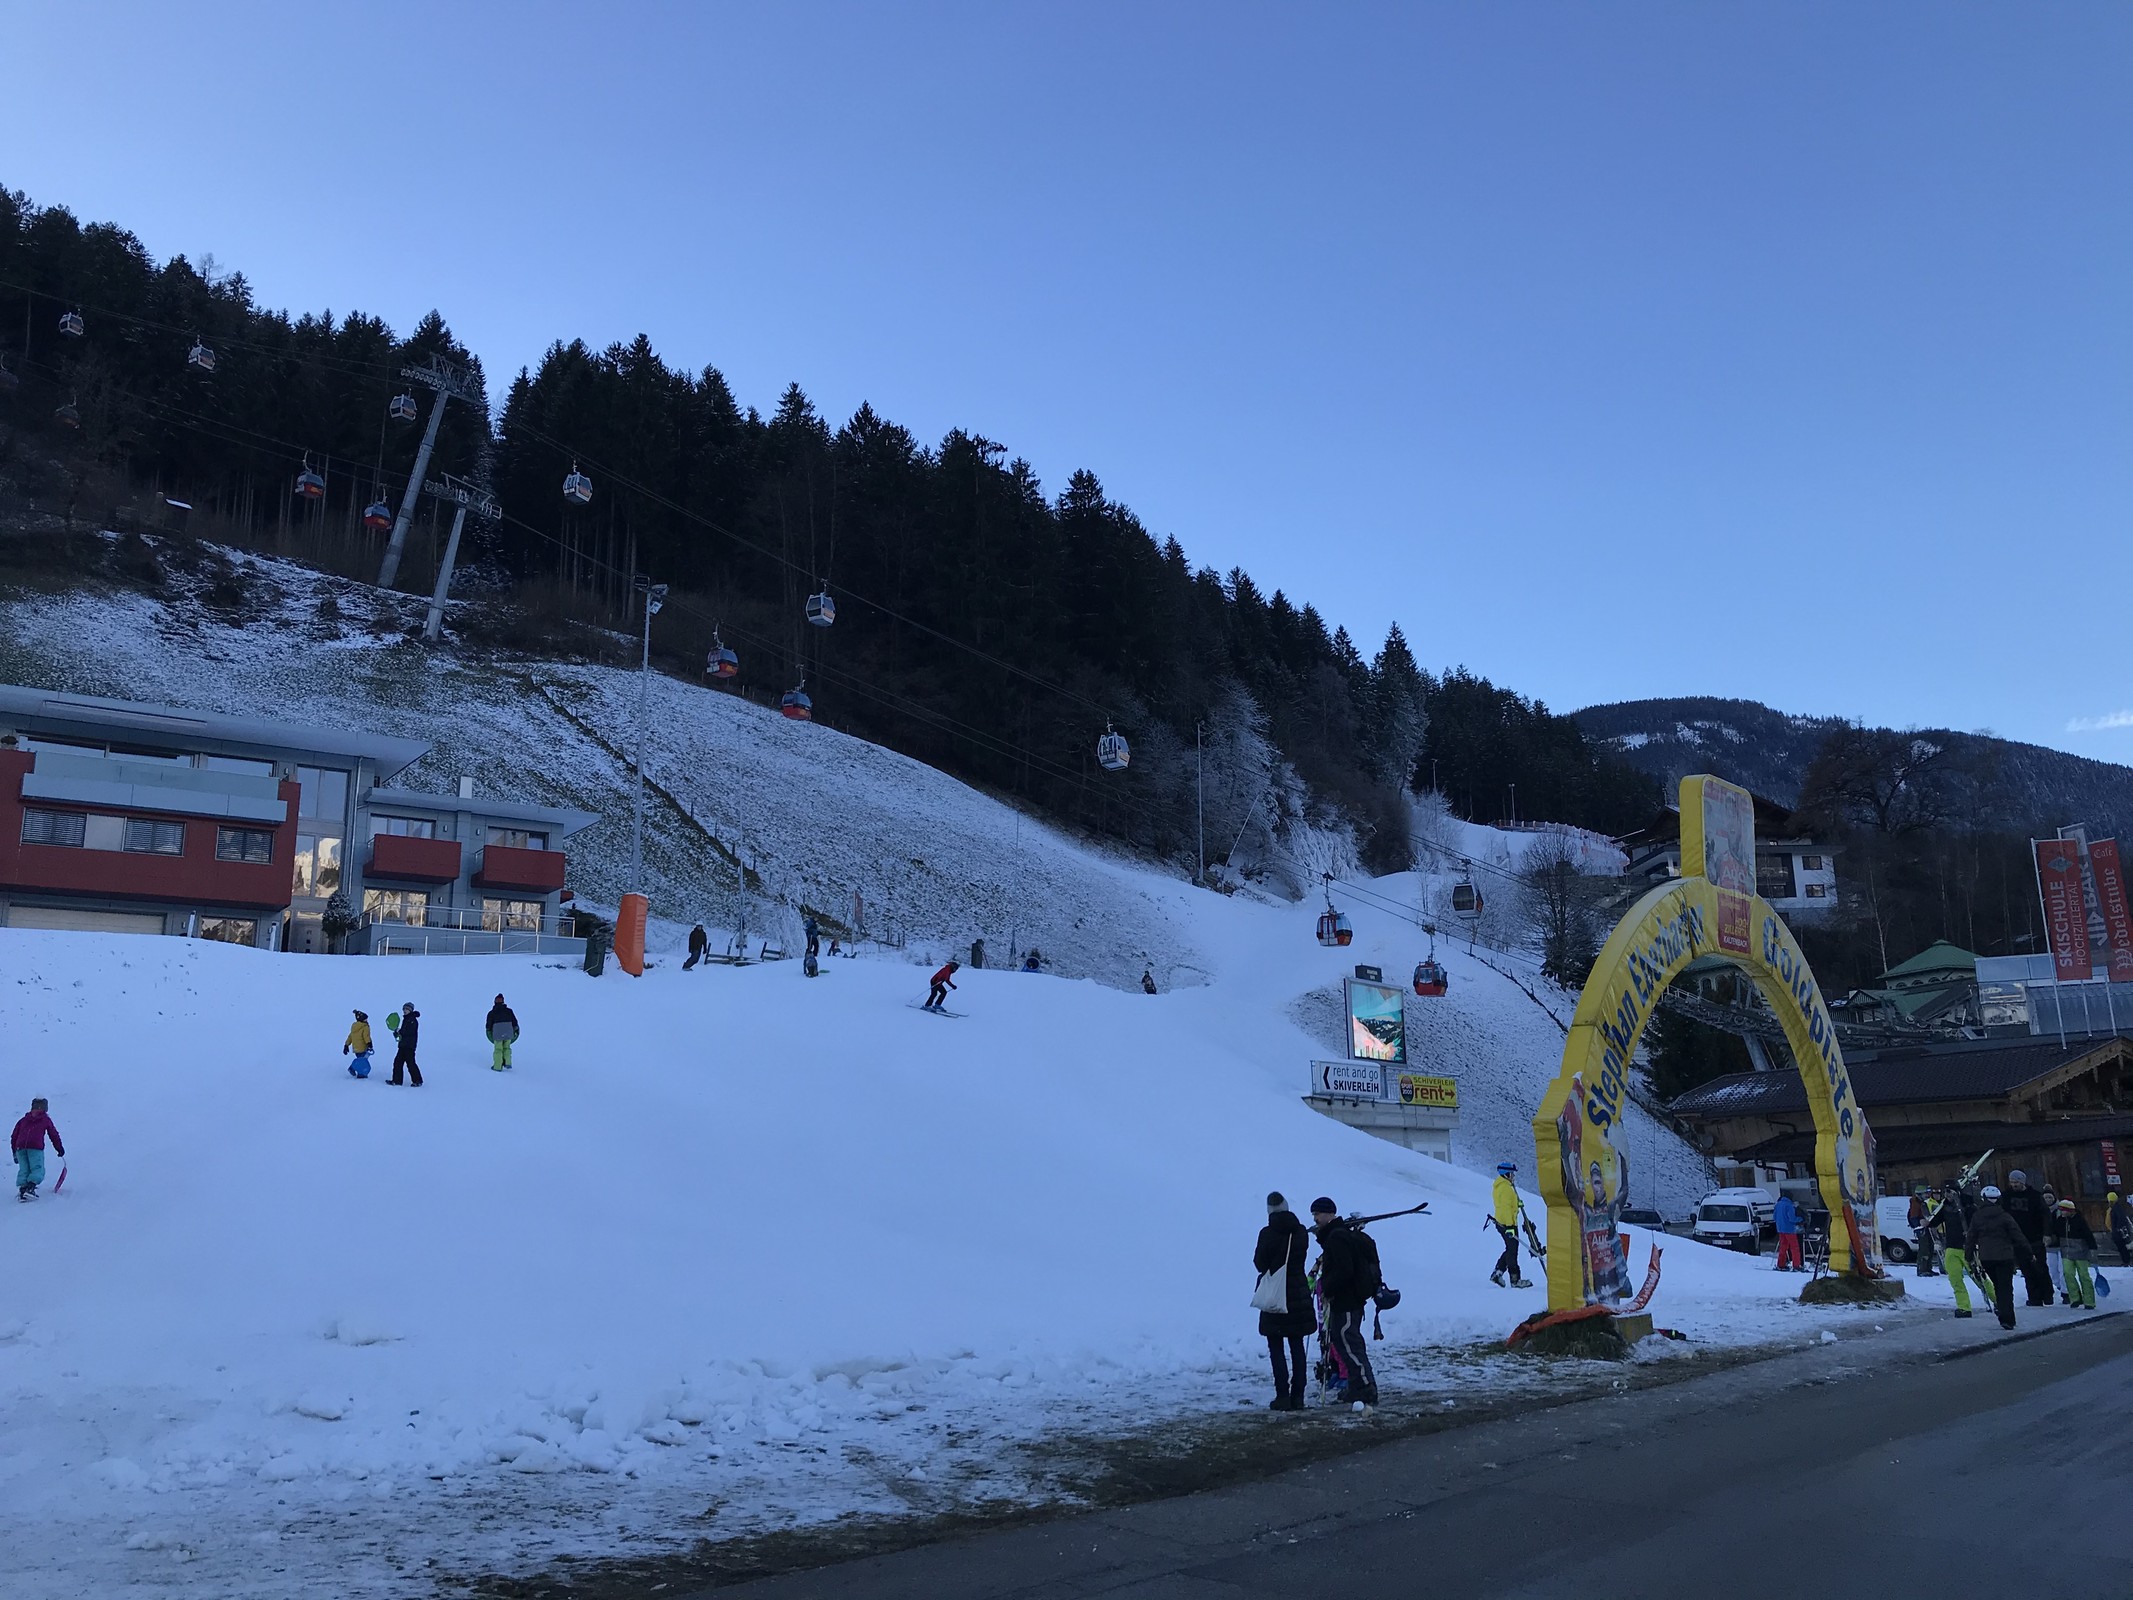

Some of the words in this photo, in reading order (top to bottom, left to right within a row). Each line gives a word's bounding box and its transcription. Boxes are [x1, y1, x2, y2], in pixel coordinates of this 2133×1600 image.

[2050, 881, 2073, 967] SKISCHULE
[2068, 881, 2086, 965] HOCHZILLERTAL
[1587, 989, 1639, 1138] Stephan
[1763, 917, 1853, 1141] Goldpiste
[1333, 1066, 1349, 1078] rent
[1352, 1068, 1367, 1079] and
[1369, 1070, 1379, 1082] go
[1333, 1079, 1379, 1094] SKIVERLEIH
[1414, 1084, 1445, 1101] rent
